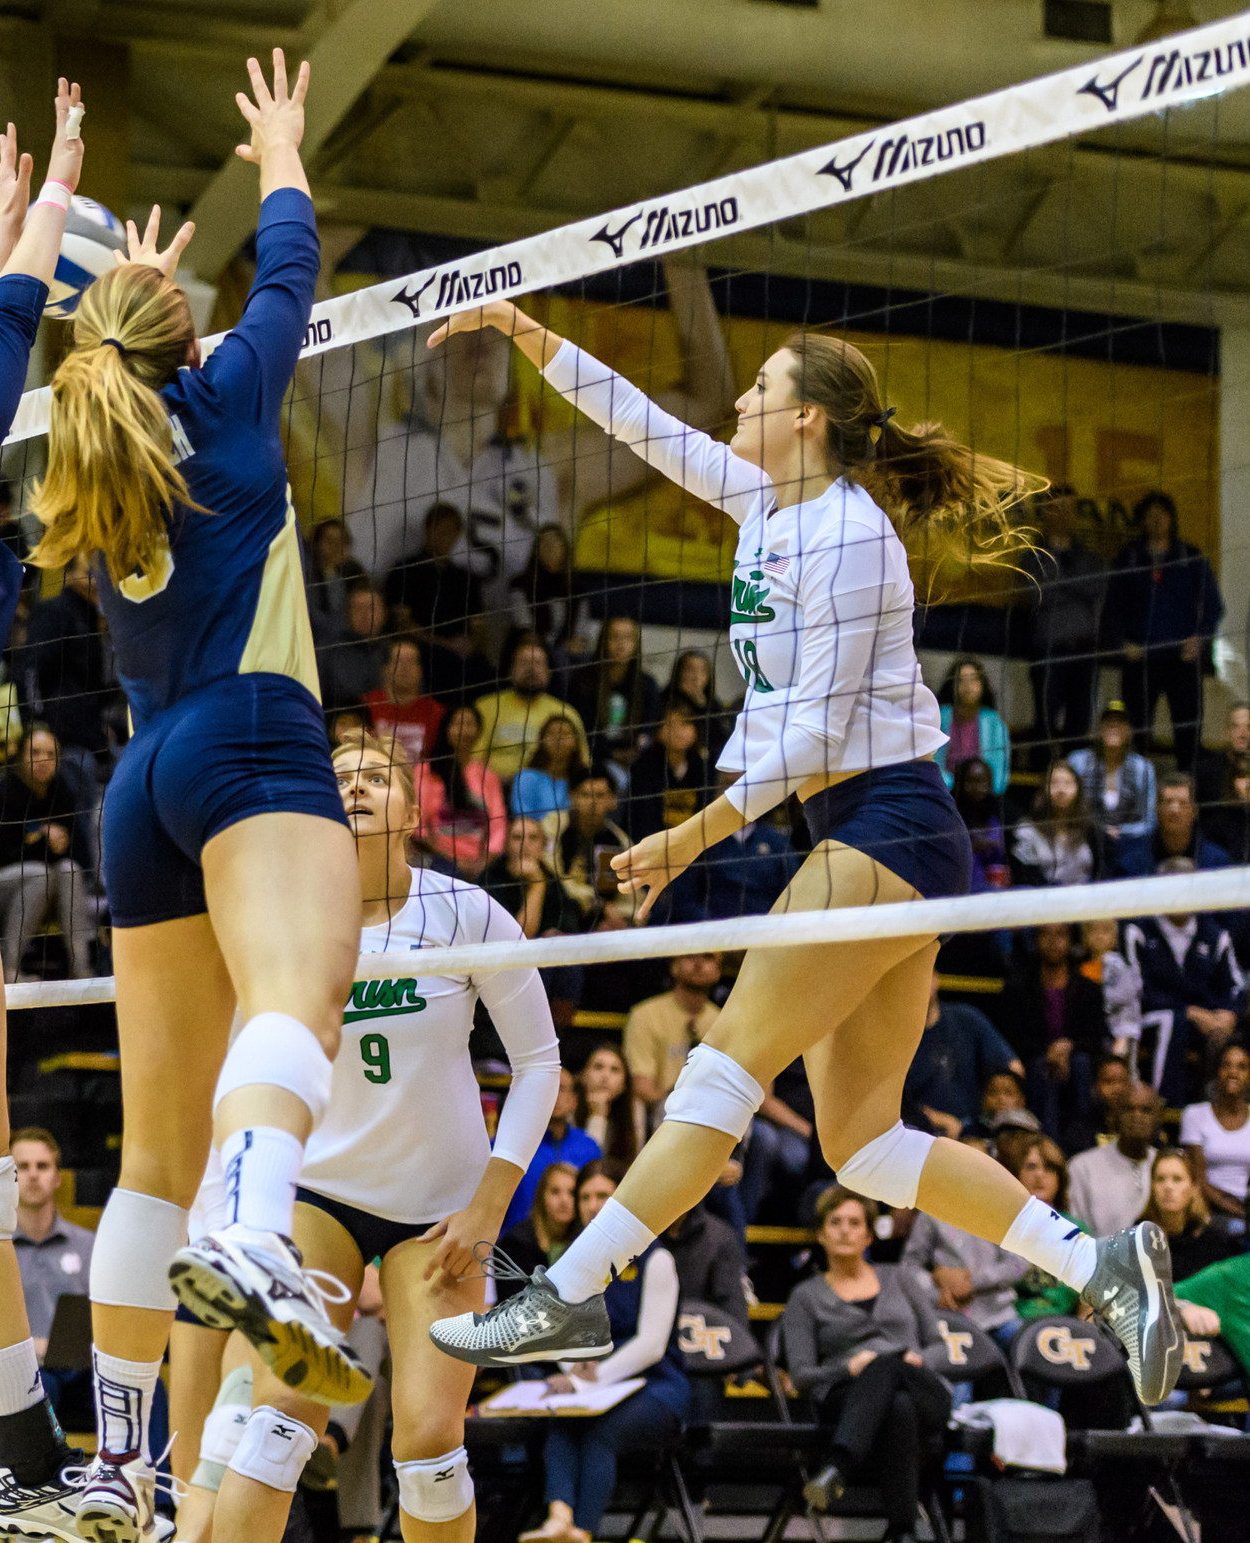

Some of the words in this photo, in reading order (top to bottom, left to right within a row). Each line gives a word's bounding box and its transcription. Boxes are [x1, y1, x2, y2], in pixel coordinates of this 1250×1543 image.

[1141, 37, 1250, 100] MIZUN
[872, 121, 985, 182] MIZUNO
[639, 197, 739, 250] MIZUNO
[434, 260, 522, 310] MIZUNO
[359, 1033, 392, 1085] 9
[938, 1319, 974, 1365] T
[1036, 1326, 1096, 1371] GT
